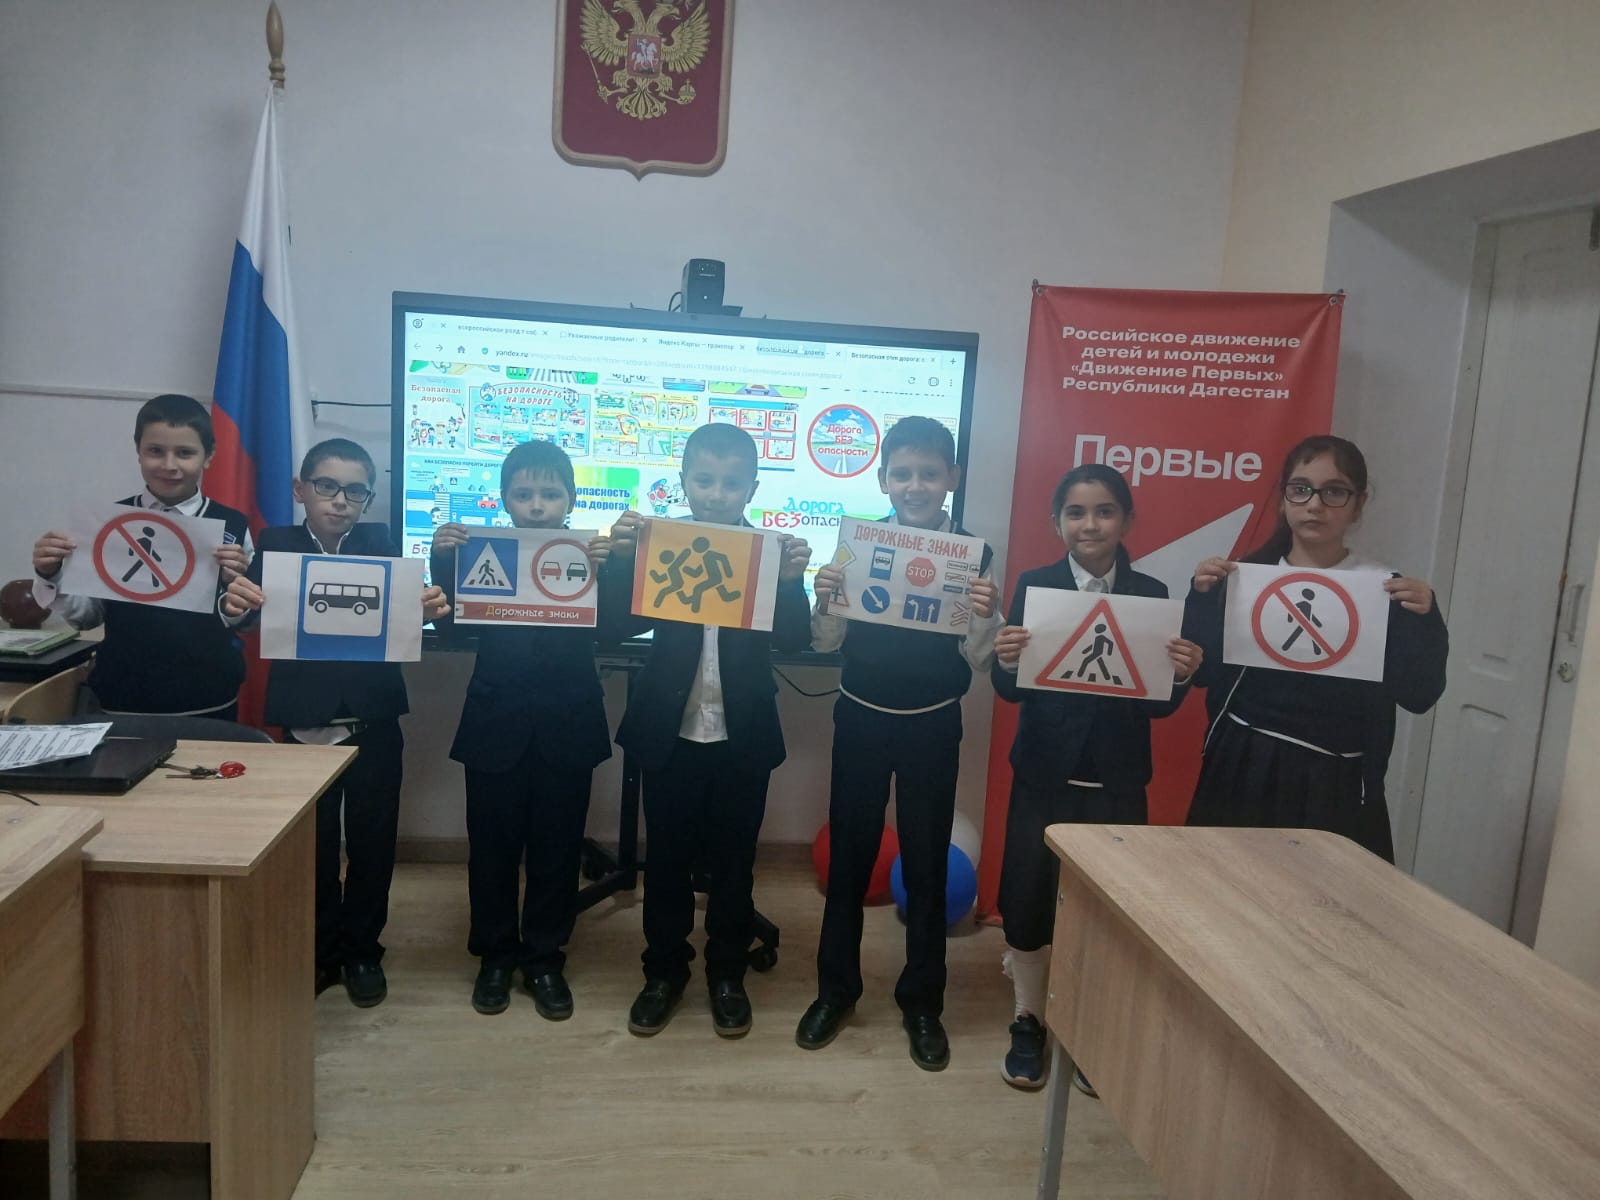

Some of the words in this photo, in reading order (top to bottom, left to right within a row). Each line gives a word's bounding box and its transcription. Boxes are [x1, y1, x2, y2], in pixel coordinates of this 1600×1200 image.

[1062, 326, 1187, 344] Российское
[1190, 332, 1300, 348] движение
[496, 349, 529, 359] yandex.ru
[1081, 345, 1142, 361] детей
[1147, 348, 1160, 360] и
[1164, 350, 1275, 365] молодежи
[1071, 361, 1187, 378] «Движение
[1191, 366, 1284, 382] Первых»
[411, 384, 462, 395] Безопасная
[497, 386, 564, 398] БЕЗОПАСНОСТЬ
[1062, 377, 1185, 395] Республики
[1189, 382, 1290, 400] Дагестан
[420, 395, 451, 405] дорога
[506, 396, 518, 404] НА
[520, 397, 553, 406] ДОРОГЕ
[827, 423, 862, 436] Дорога
[835, 435, 853, 445] БЕЗ
[818, 447, 868, 457] опасности
[1073, 434, 1263, 487] Первые
[575, 486, 630, 498] опасность
[575, 499, 587, 508] на
[589, 500, 630, 511] дорогах
[854, 524, 925, 552] ДОРОЖНЫЕ
[927, 538, 969, 559] ЗНАКИ
[411, 543, 430, 555] Бе
[907, 566, 935, 578] STOP
[485, 605, 544, 618] Дорожные
[548, 610, 580, 620] знаки
